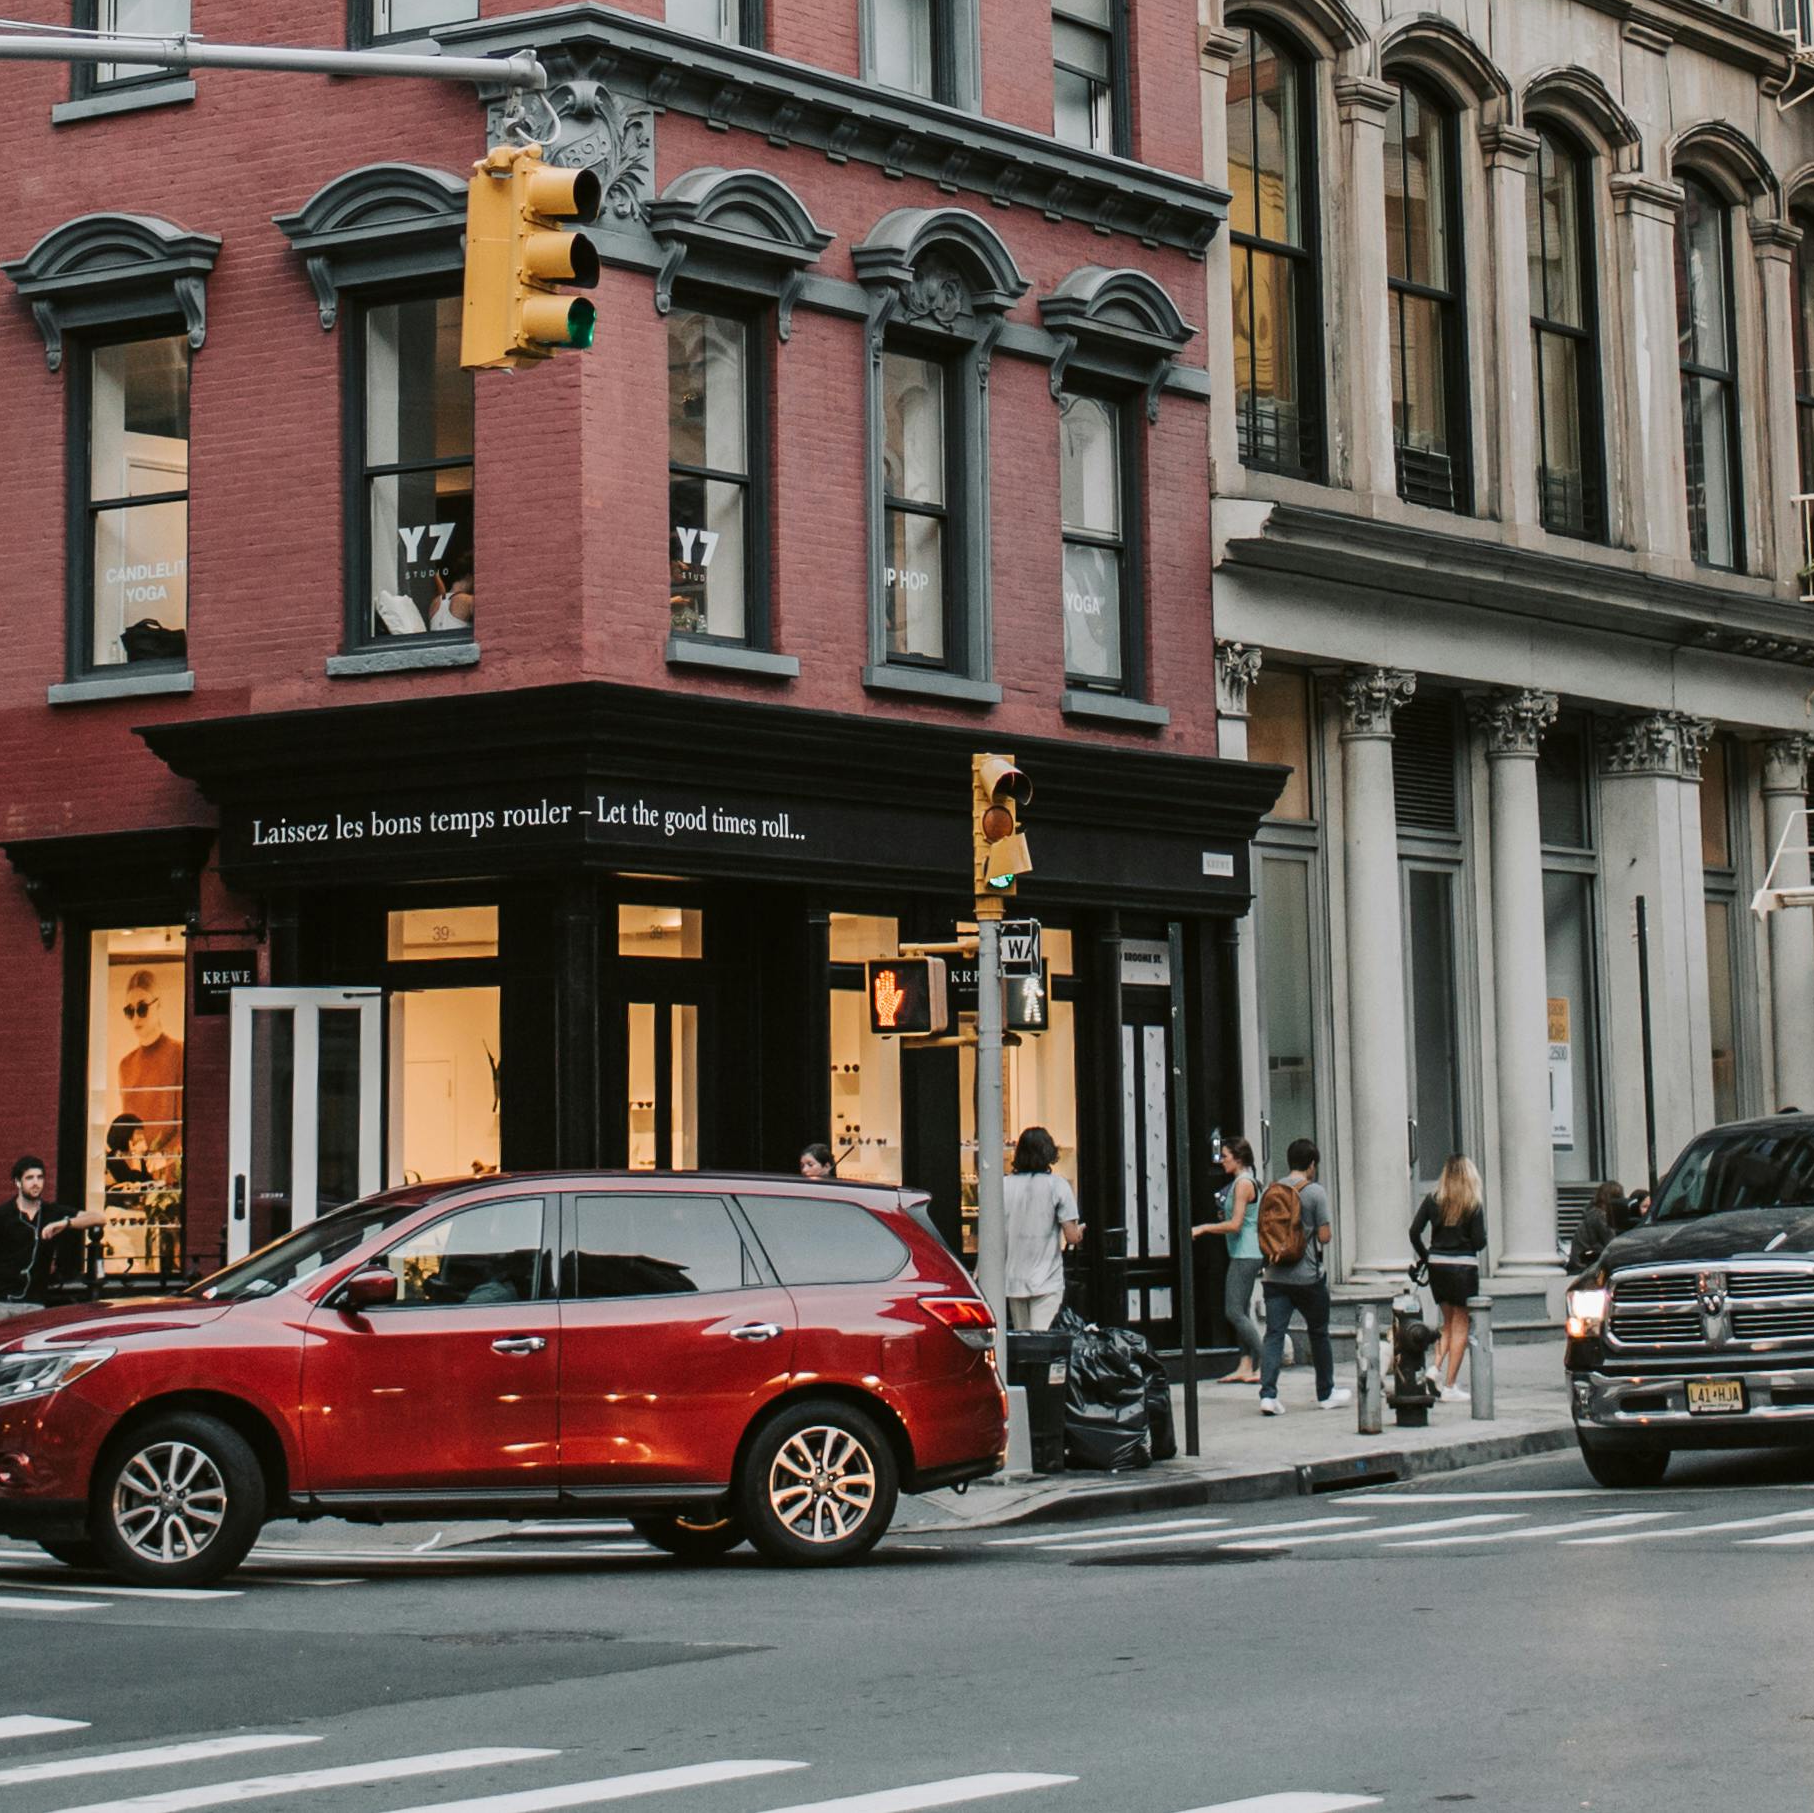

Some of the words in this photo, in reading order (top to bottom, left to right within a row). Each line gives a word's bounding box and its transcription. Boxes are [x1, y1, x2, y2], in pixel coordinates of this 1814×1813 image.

[398, 522, 456, 563] Y7
[675, 526, 720, 567] Y7
[106, 559, 187, 584] CANDLELIT
[405, 567, 449, 580] STUDIO
[883, 567, 897, 587] IP
[900, 569, 929, 591] HOP
[126, 585, 167, 603] YOGA
[1065, 591, 1101, 616] YOGA
[252, 817, 329, 846] Laissez
[335, 814, 364, 840] les
[371, 811, 422, 836] bons
[429, 810, 495, 838] temps
[502, 798, 572, 828] rouler
[597, 795, 626, 824] Let
[632, 799, 659, 827] the
[665, 805, 707, 836] good
[712, 807, 757, 836] times
[762, 813, 806, 841] roll...
[202, 970, 251, 985] KREWE
